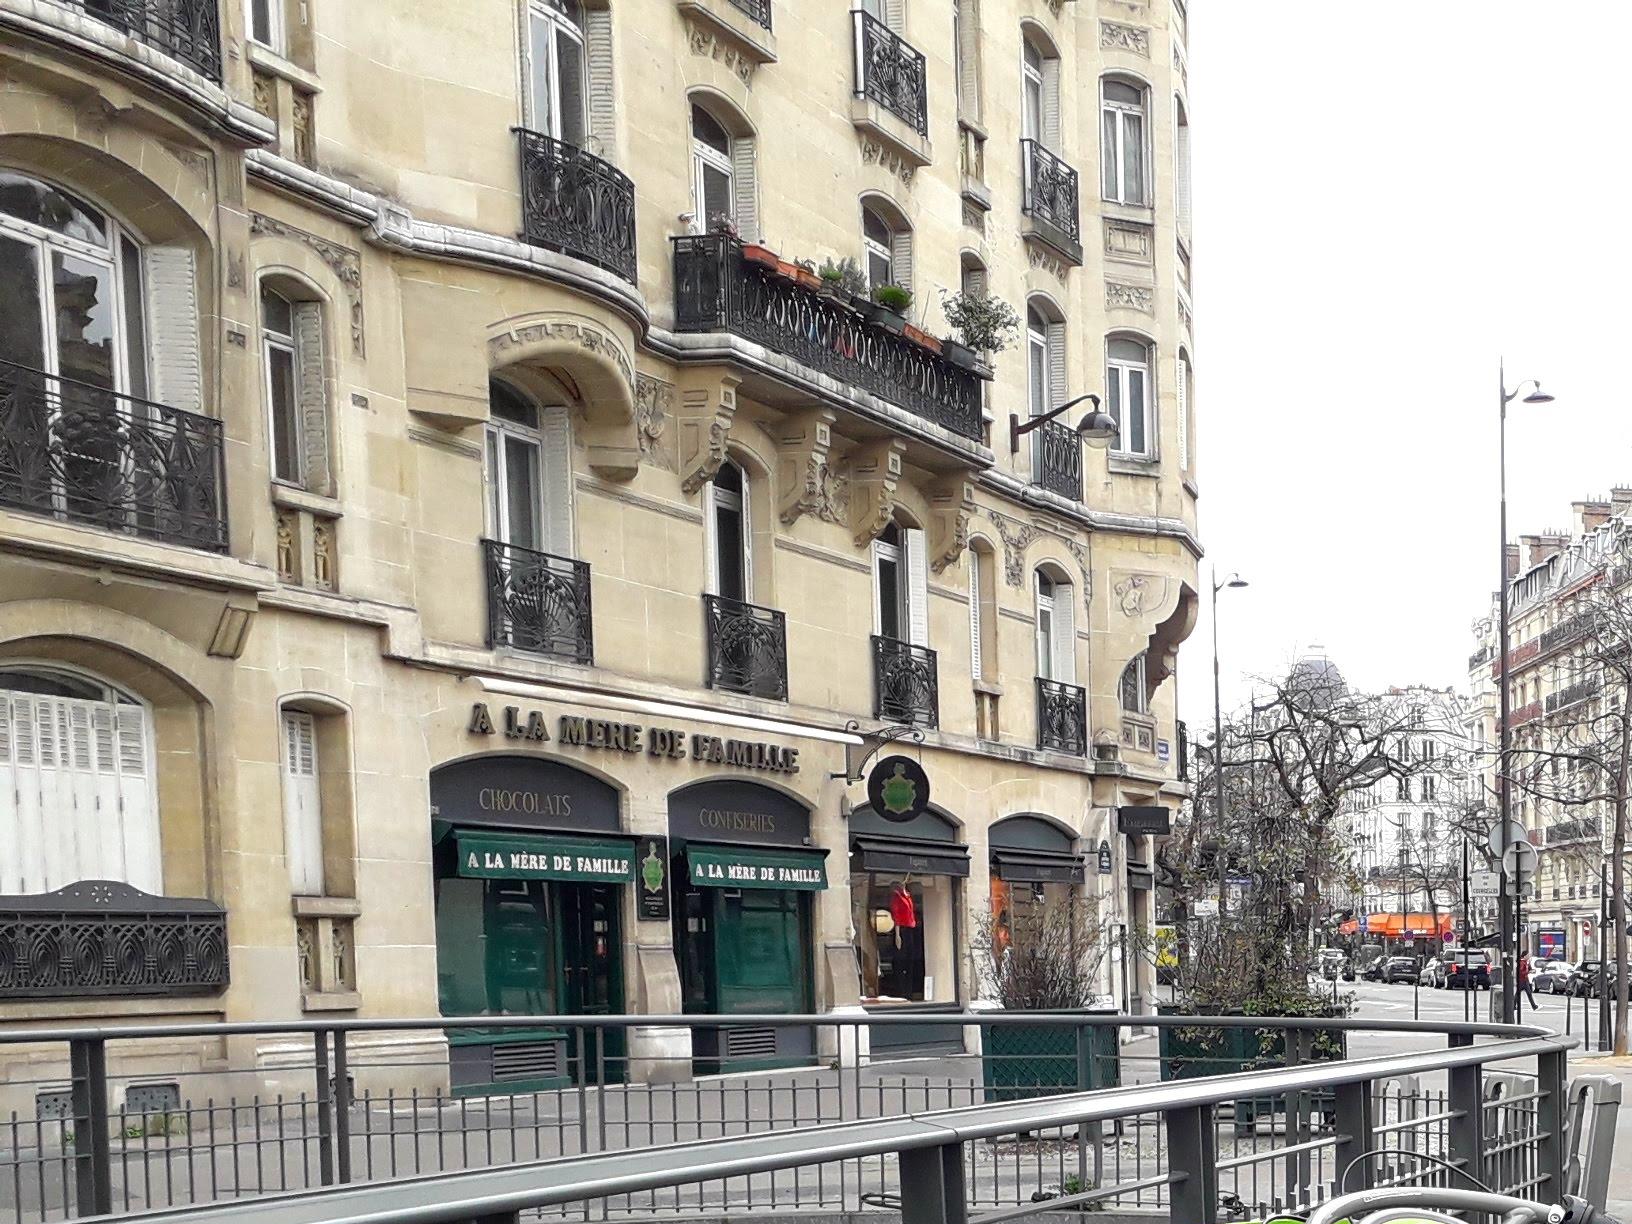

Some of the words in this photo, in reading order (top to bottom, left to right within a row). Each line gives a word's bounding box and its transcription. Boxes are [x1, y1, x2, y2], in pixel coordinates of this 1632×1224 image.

[469, 703, 496, 735] A
[504, 706, 550, 742] LA
[650, 727, 686, 759] DE
[692, 734, 800, 774] FAMILLE
[479, 787, 571, 817] CHOCOLATS
[700, 808, 776, 833] CONFISERIES
[468, 852, 479, 868] A
[485, 852, 504, 869] LA
[510, 850, 547, 870] MÈRE
[553, 855, 572, 872] DE
[577, 857, 629, 874] FAMILLE
[695, 863, 704, 877] A
[708, 864, 724, 878] LA
[728, 863, 757, 880] MÈRE
[760, 867, 775, 881] DE
[779, 867, 821, 883] FAMILLE
